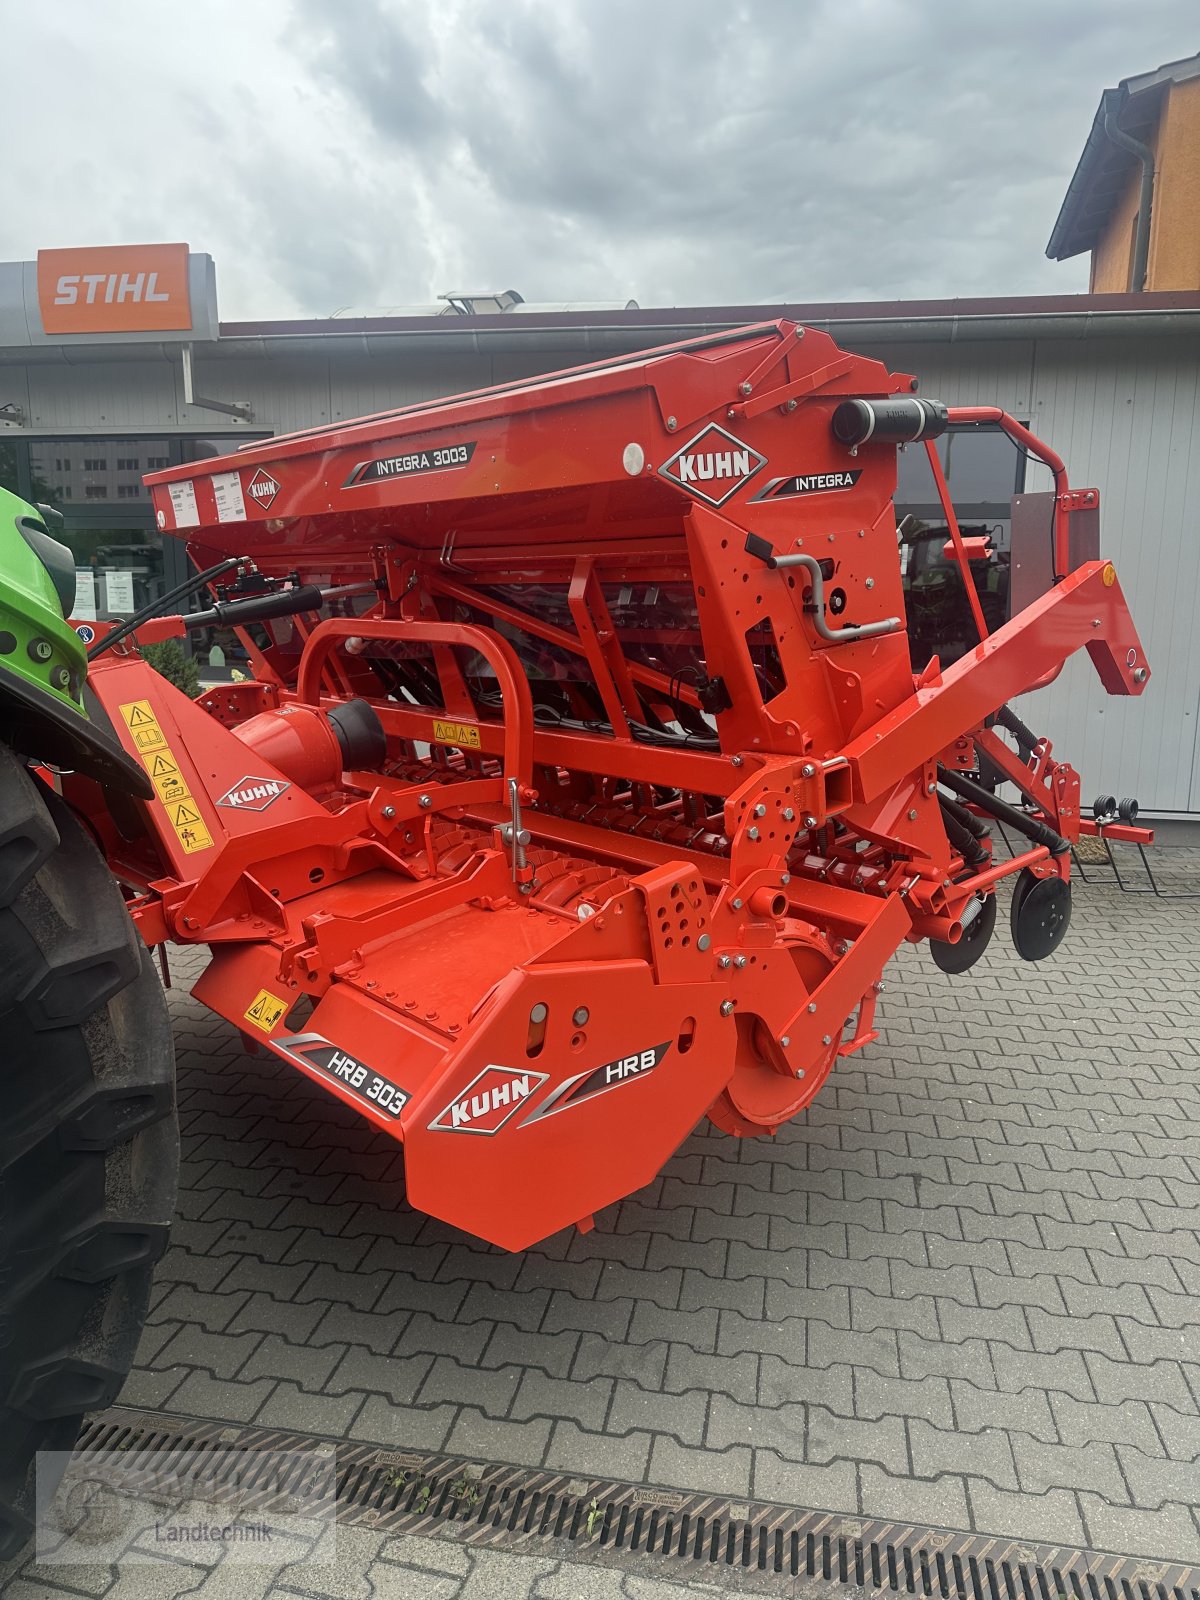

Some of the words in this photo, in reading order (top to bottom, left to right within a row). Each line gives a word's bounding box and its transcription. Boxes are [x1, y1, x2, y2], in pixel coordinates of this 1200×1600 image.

[54, 272, 170, 305] STIHL
[376, 453, 430, 476] INTEGRA
[433, 446, 468, 466] 3003
[678, 449, 750, 482] KUHN
[251, 480, 276, 498] KUHN
[795, 472, 854, 491] INTEGRA
[227, 782, 280, 806] KUHN
[327, 1051, 367, 1089] HRB
[366, 1076, 408, 1116] 303
[605, 1049, 656, 1085] HRB
[450, 1075, 531, 1129] KUHN
